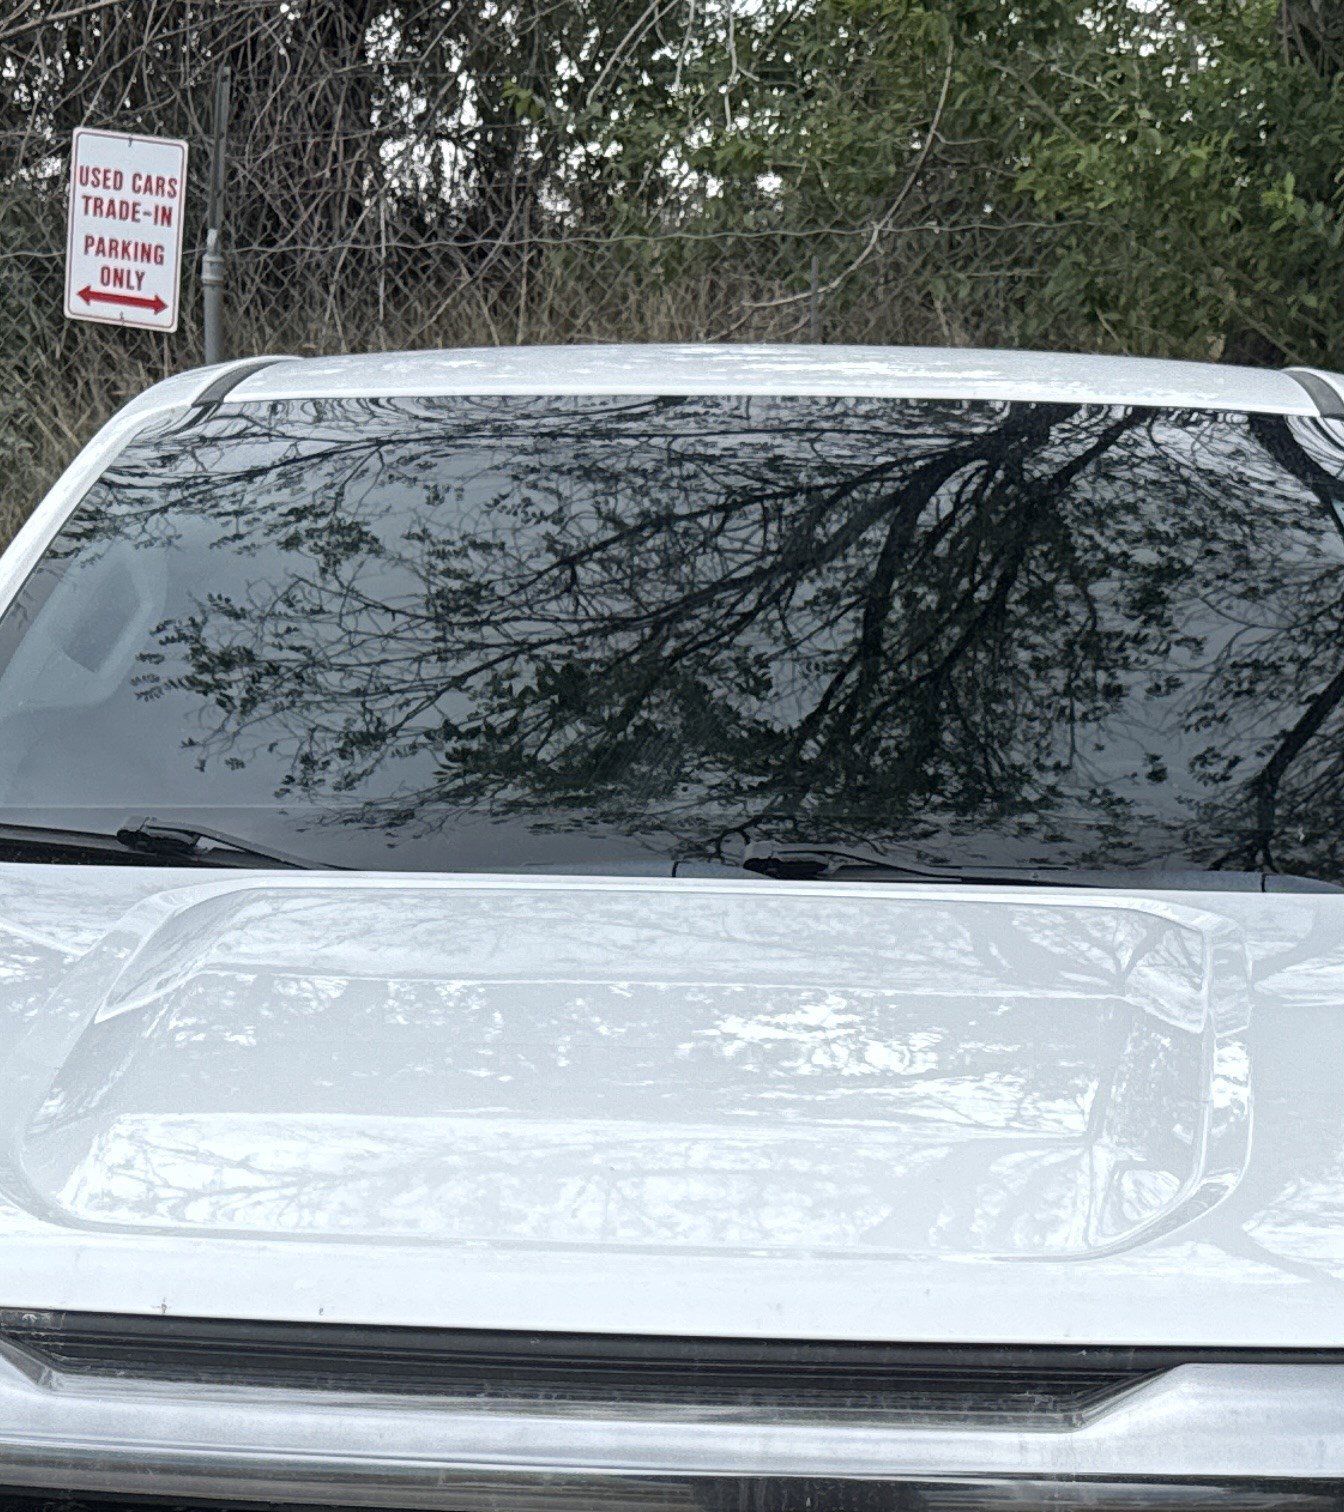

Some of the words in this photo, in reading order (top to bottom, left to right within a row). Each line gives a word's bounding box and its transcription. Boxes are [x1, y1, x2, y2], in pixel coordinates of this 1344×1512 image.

[79, 165, 123, 191] USED
[132, 172, 178, 198] CARS
[82, 195, 173, 227] TRADE-IN
[84, 233, 165, 265] PARKING
[100, 266, 146, 291] ONLY
